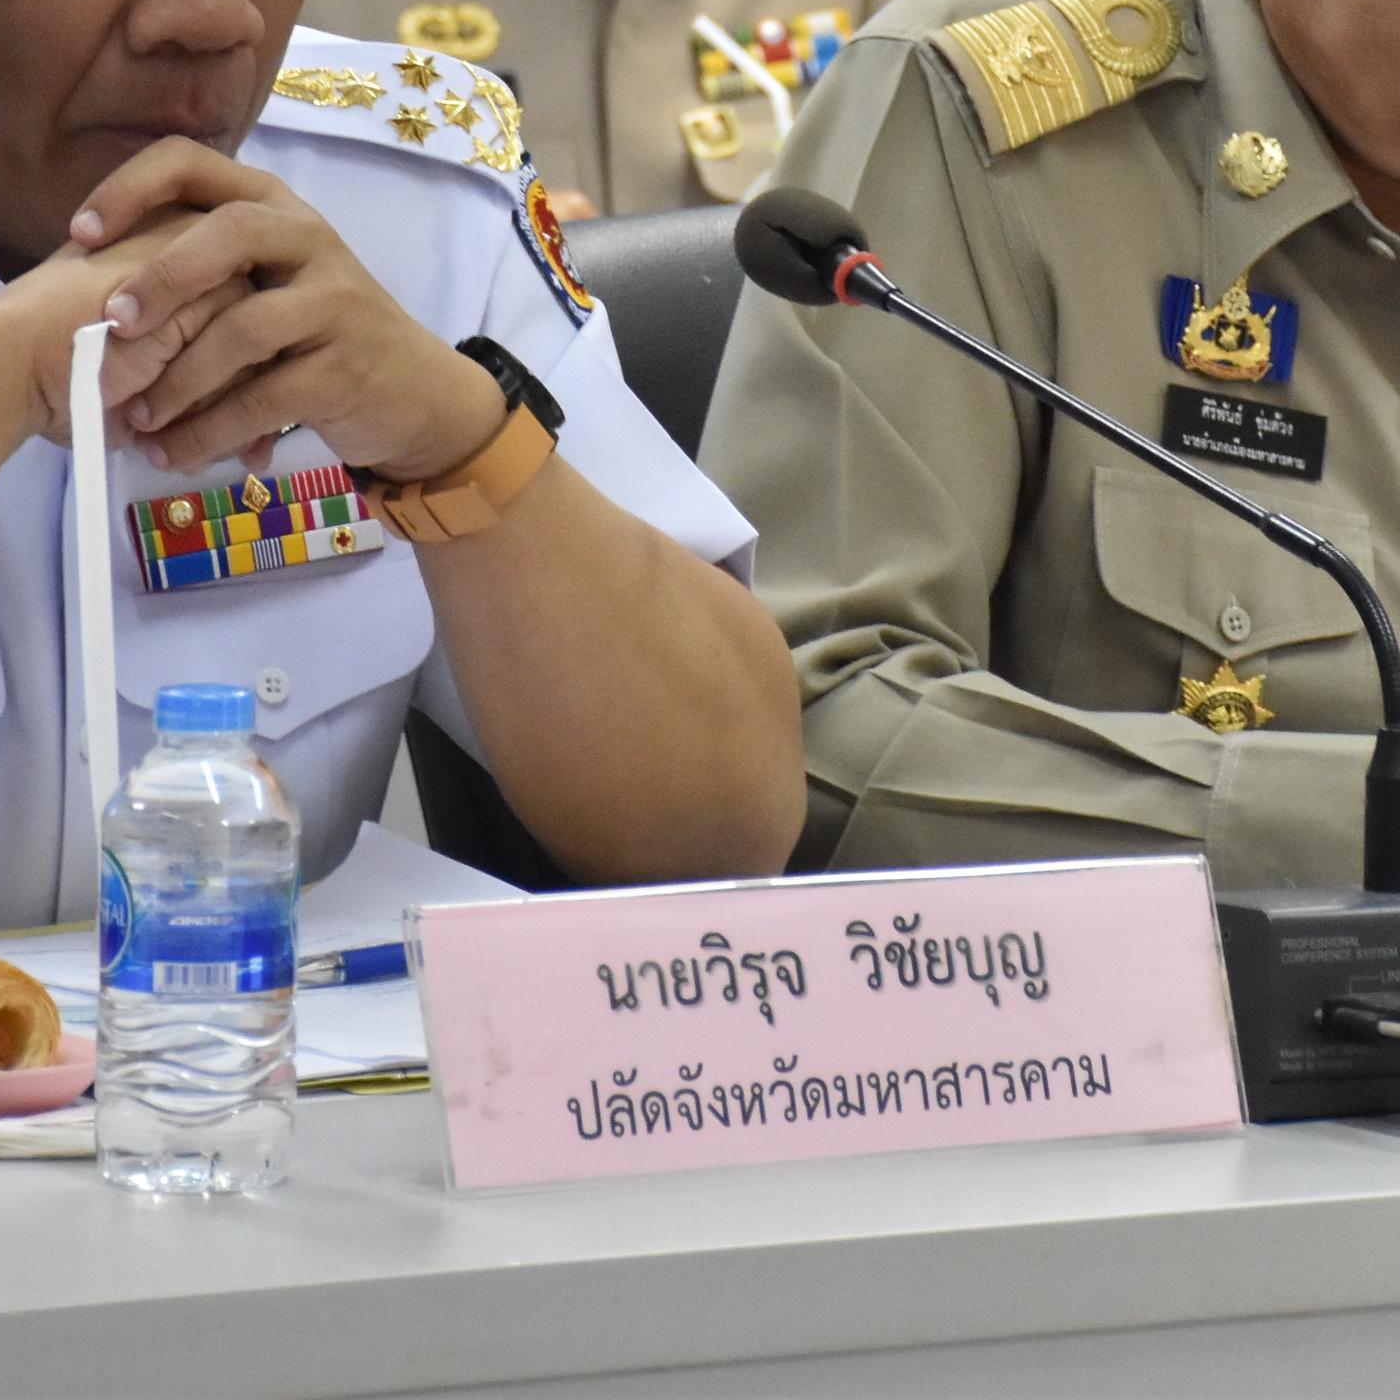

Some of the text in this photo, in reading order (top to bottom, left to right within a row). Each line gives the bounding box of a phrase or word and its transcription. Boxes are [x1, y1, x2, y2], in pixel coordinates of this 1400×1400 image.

[596, 912, 1050, 1027] นายวิรุจ วิชัยบุญ
[567, 1053, 1112, 1141] ปลัดจังหวัดมหาสารคาม
